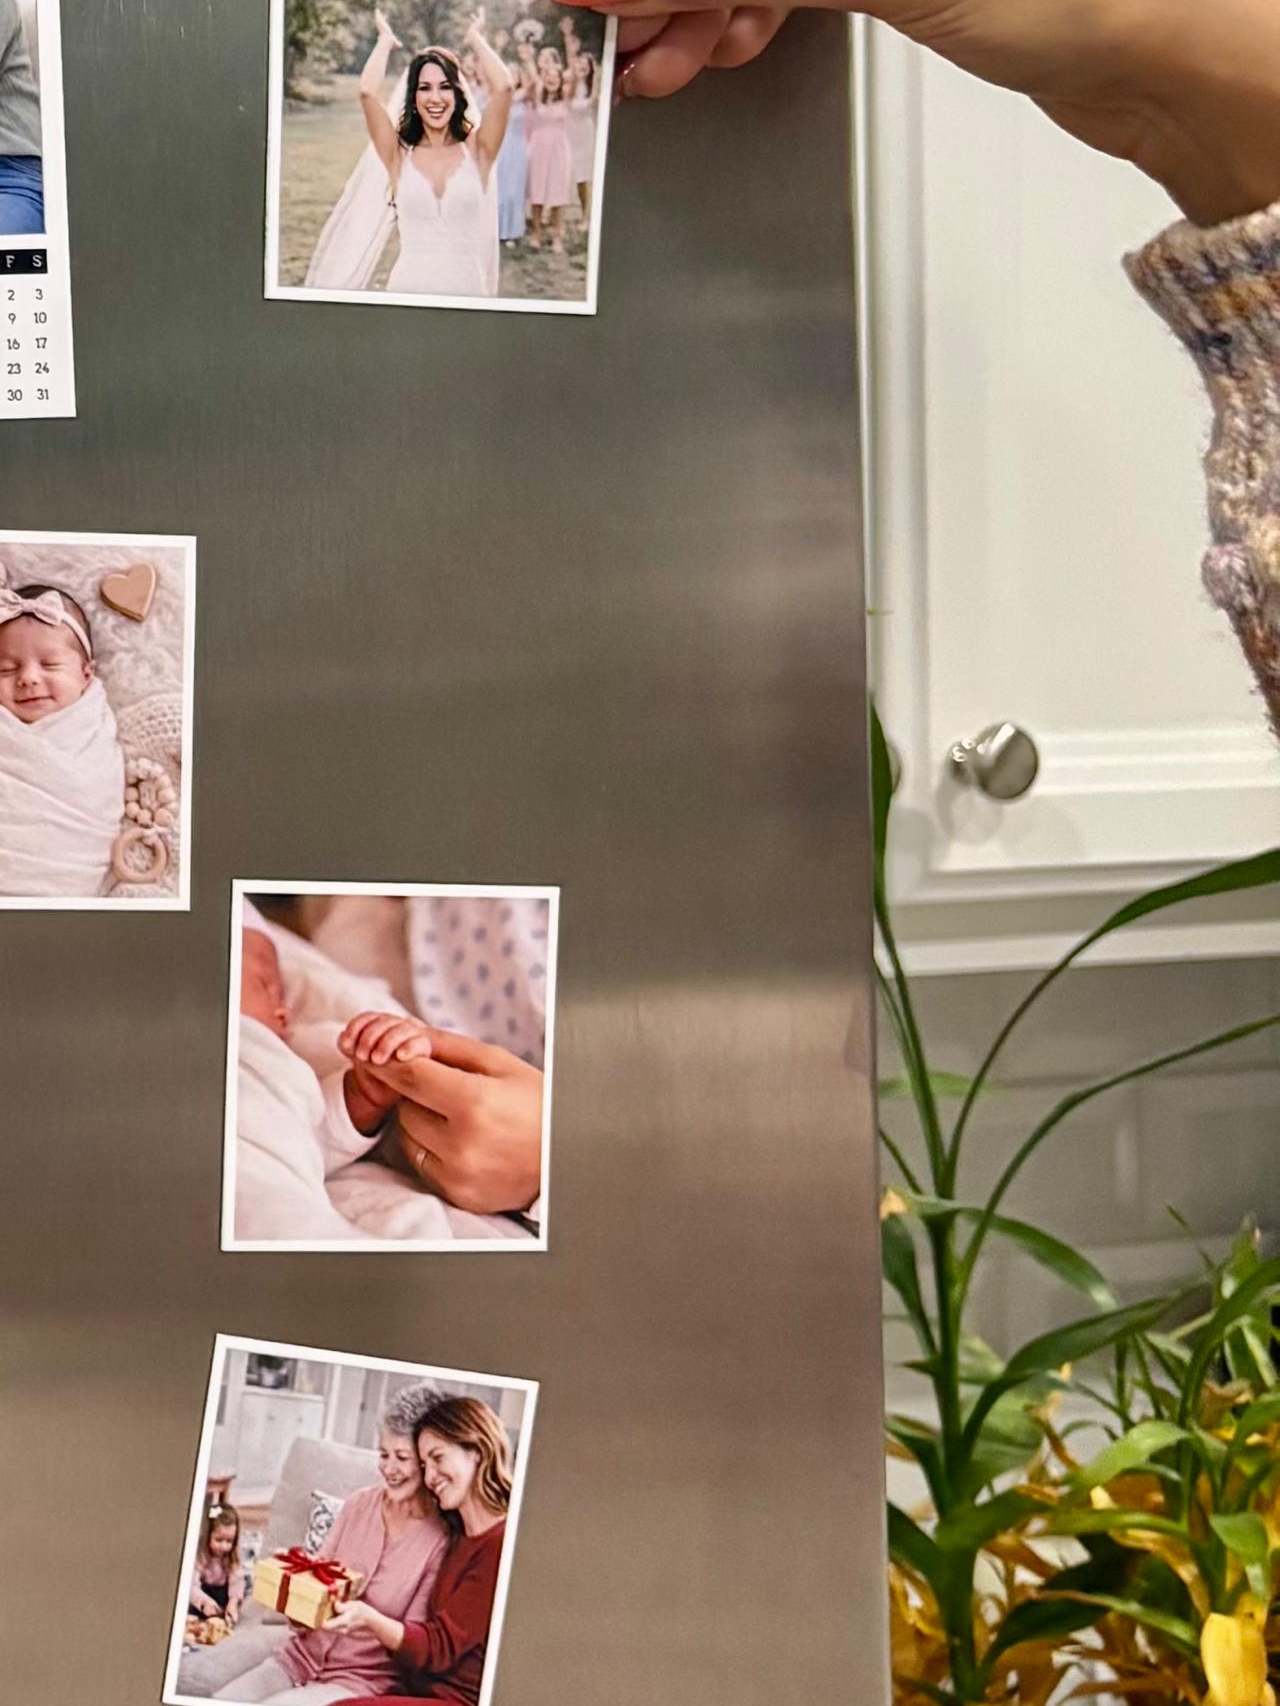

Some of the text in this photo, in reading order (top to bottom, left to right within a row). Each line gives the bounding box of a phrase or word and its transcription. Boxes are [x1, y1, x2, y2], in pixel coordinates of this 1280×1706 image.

[5, 254, 15, 269] F
[32, 254, 44, 268] S
[7, 289, 15, 301] 2
[35, 288, 44, 301] 3
[7, 312, 17, 325] 9
[33, 311, 48, 324] 10
[6, 338, 21, 351] 16
[35, 336, 48, 350] 17
[7, 362, 22, 375] 23
[34, 362, 50, 374] 24
[7, 388, 23, 402] 30
[36, 387, 50, 401] 31
